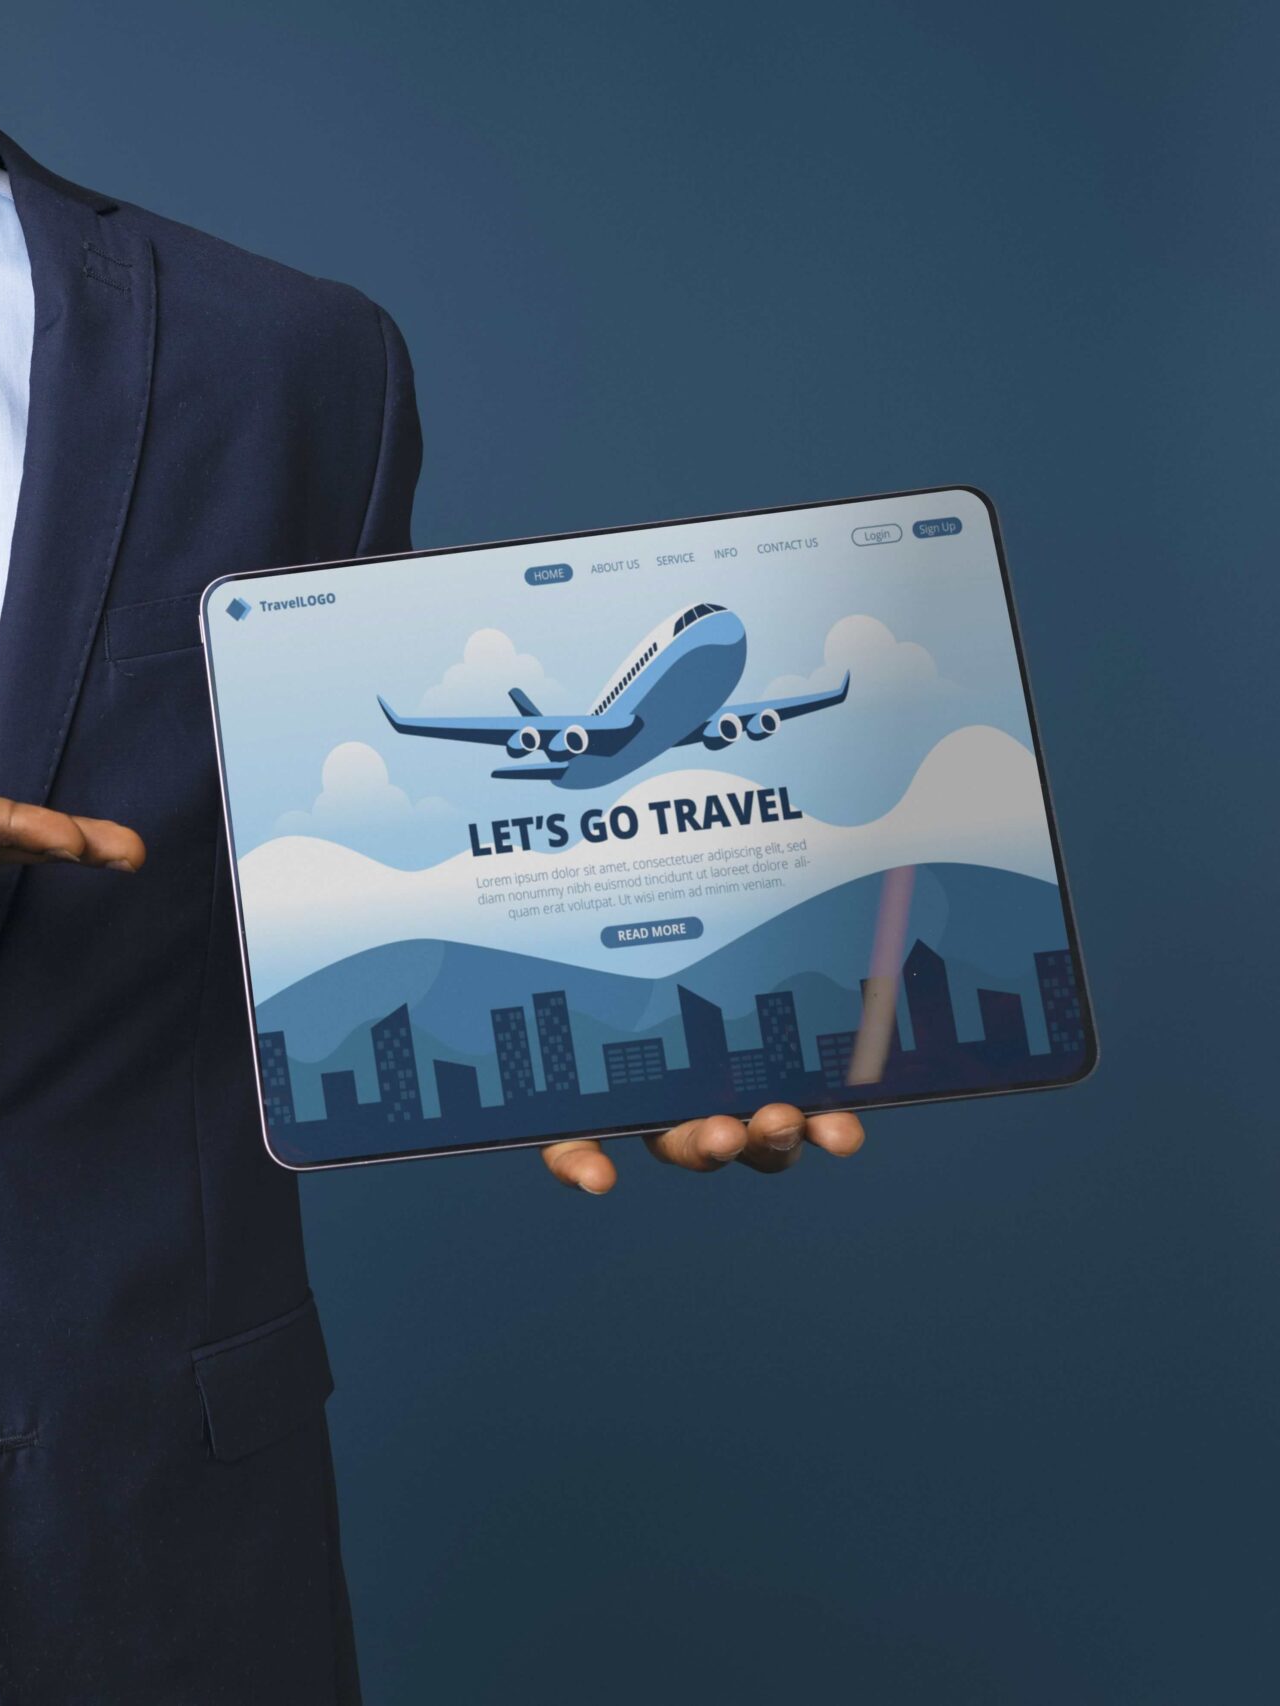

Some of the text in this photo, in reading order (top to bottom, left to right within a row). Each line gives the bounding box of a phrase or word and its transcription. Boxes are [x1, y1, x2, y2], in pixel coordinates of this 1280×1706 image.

[864, 529, 890, 542] Login
[919, 521, 956, 536] Sign Up
[714, 547, 738, 559] INFO
[757, 537, 819, 554] CONTACT US
[591, 559, 640, 574] ABOUT US
[656, 552, 695, 566] SERVICE
[534, 568, 565, 581] HOME
[259, 592, 336, 612] TravelLOGO
[580, 805, 639, 843] GO
[648, 786, 803, 835] TRAVEL
[476, 874, 512, 889] Lorem
[515, 870, 549, 884] ipsum
[552, 867, 580, 880] dolor
[584, 864, 596, 876] sit
[599, 861, 630, 875] amet,
[633, 852, 704, 870] consectetuer
[708, 845, 763, 862] adipiscing
[787, 839, 807, 853] sed
[478, 893, 505, 905] diam
[508, 886, 564, 902] nonummy
[567, 881, 591, 895] nibh
[594, 876, 641, 892] euismod
[645, 870, 693, 886] tincidunt
[696, 869, 708, 880] ut
[710, 863, 749, 878] laoreet
[752, 859, 788, 873] dolore
[508, 876, 785, 921] quam erat volutpat. Ut wisi enim ad minim veniam.
[617, 923, 687, 942] READ MORE
